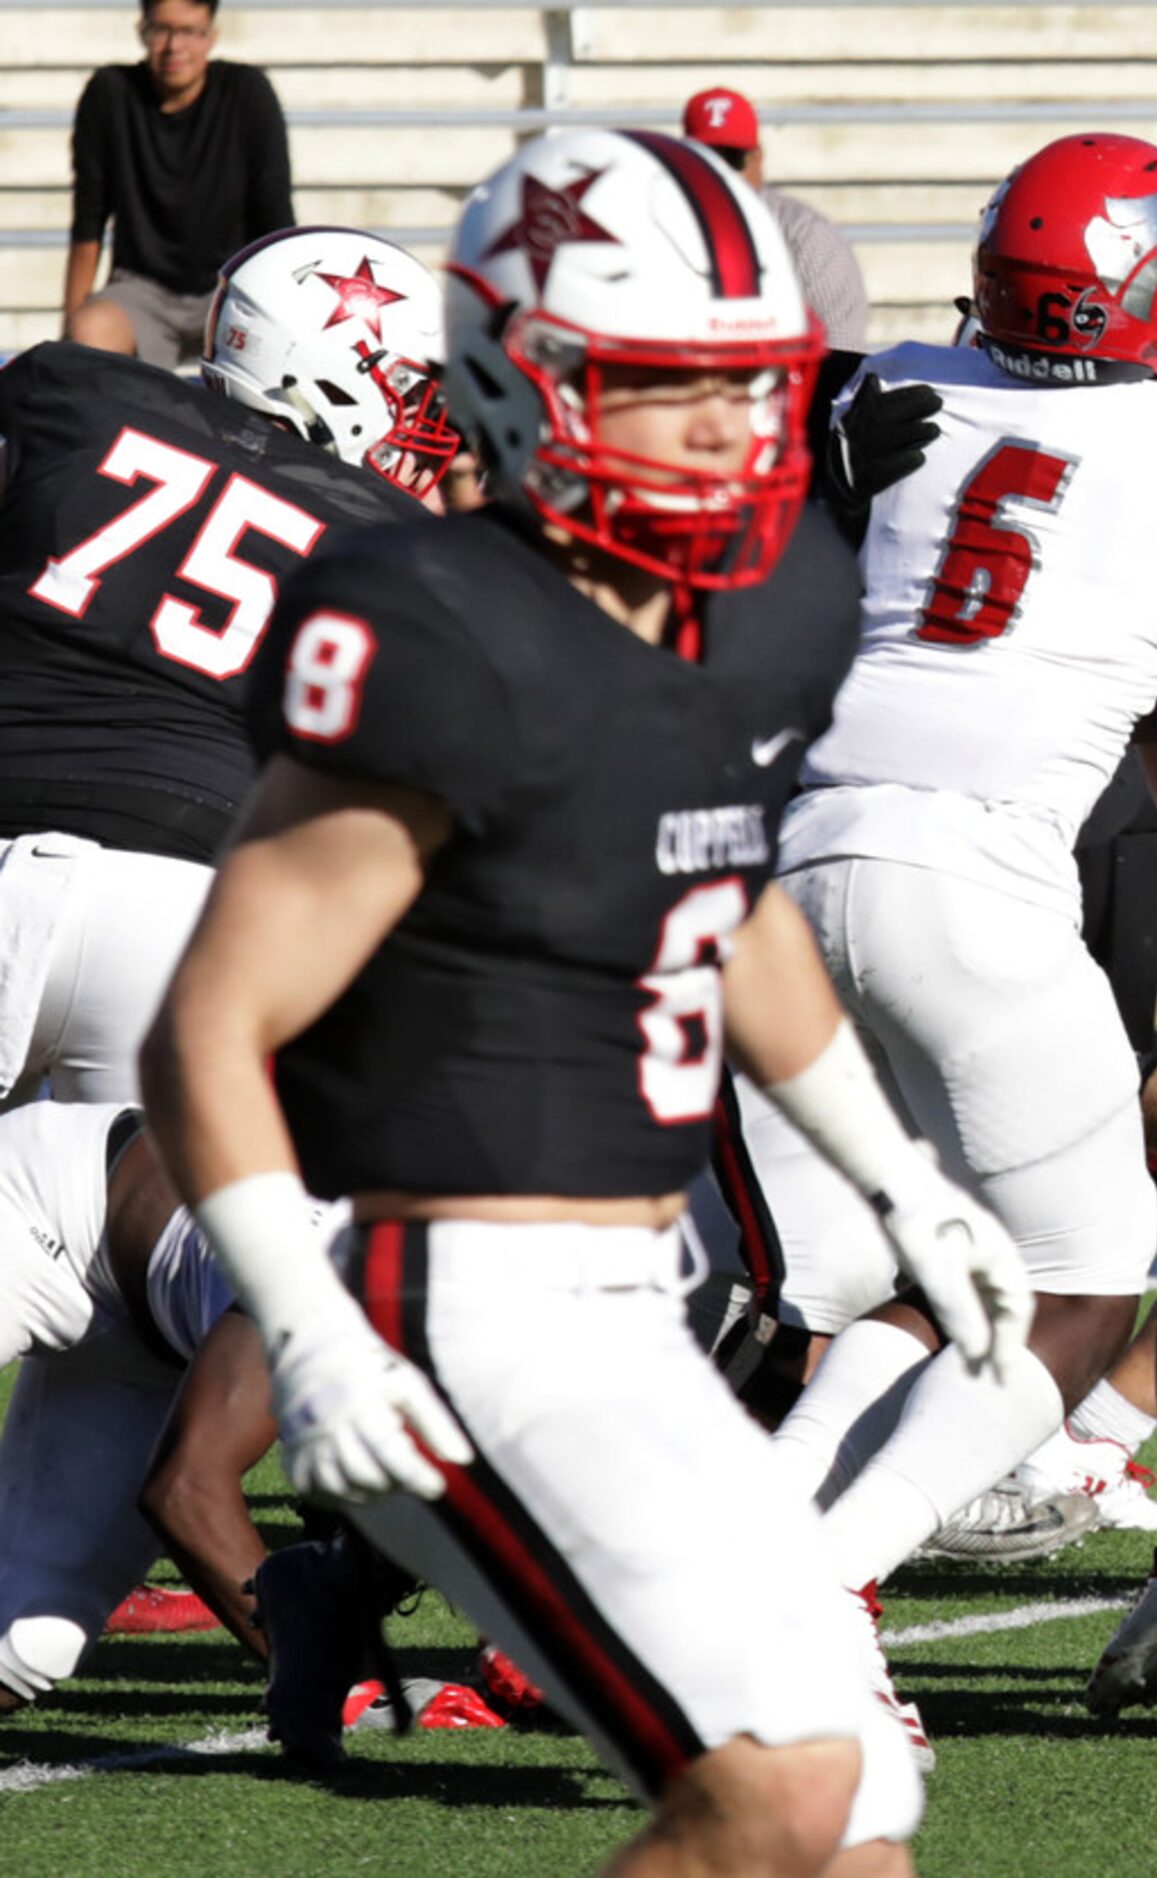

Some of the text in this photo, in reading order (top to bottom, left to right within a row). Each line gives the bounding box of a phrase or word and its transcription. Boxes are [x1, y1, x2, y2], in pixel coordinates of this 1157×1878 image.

[704, 98, 733, 128] T
[224, 326, 247, 351] 75
[989, 345, 1097, 381] Riddell
[1037, 292, 1072, 346] 6
[28, 425, 327, 681] 75
[908, 436, 1082, 653] 6
[282, 608, 379, 745] 8
[634, 875, 747, 1131] 8
